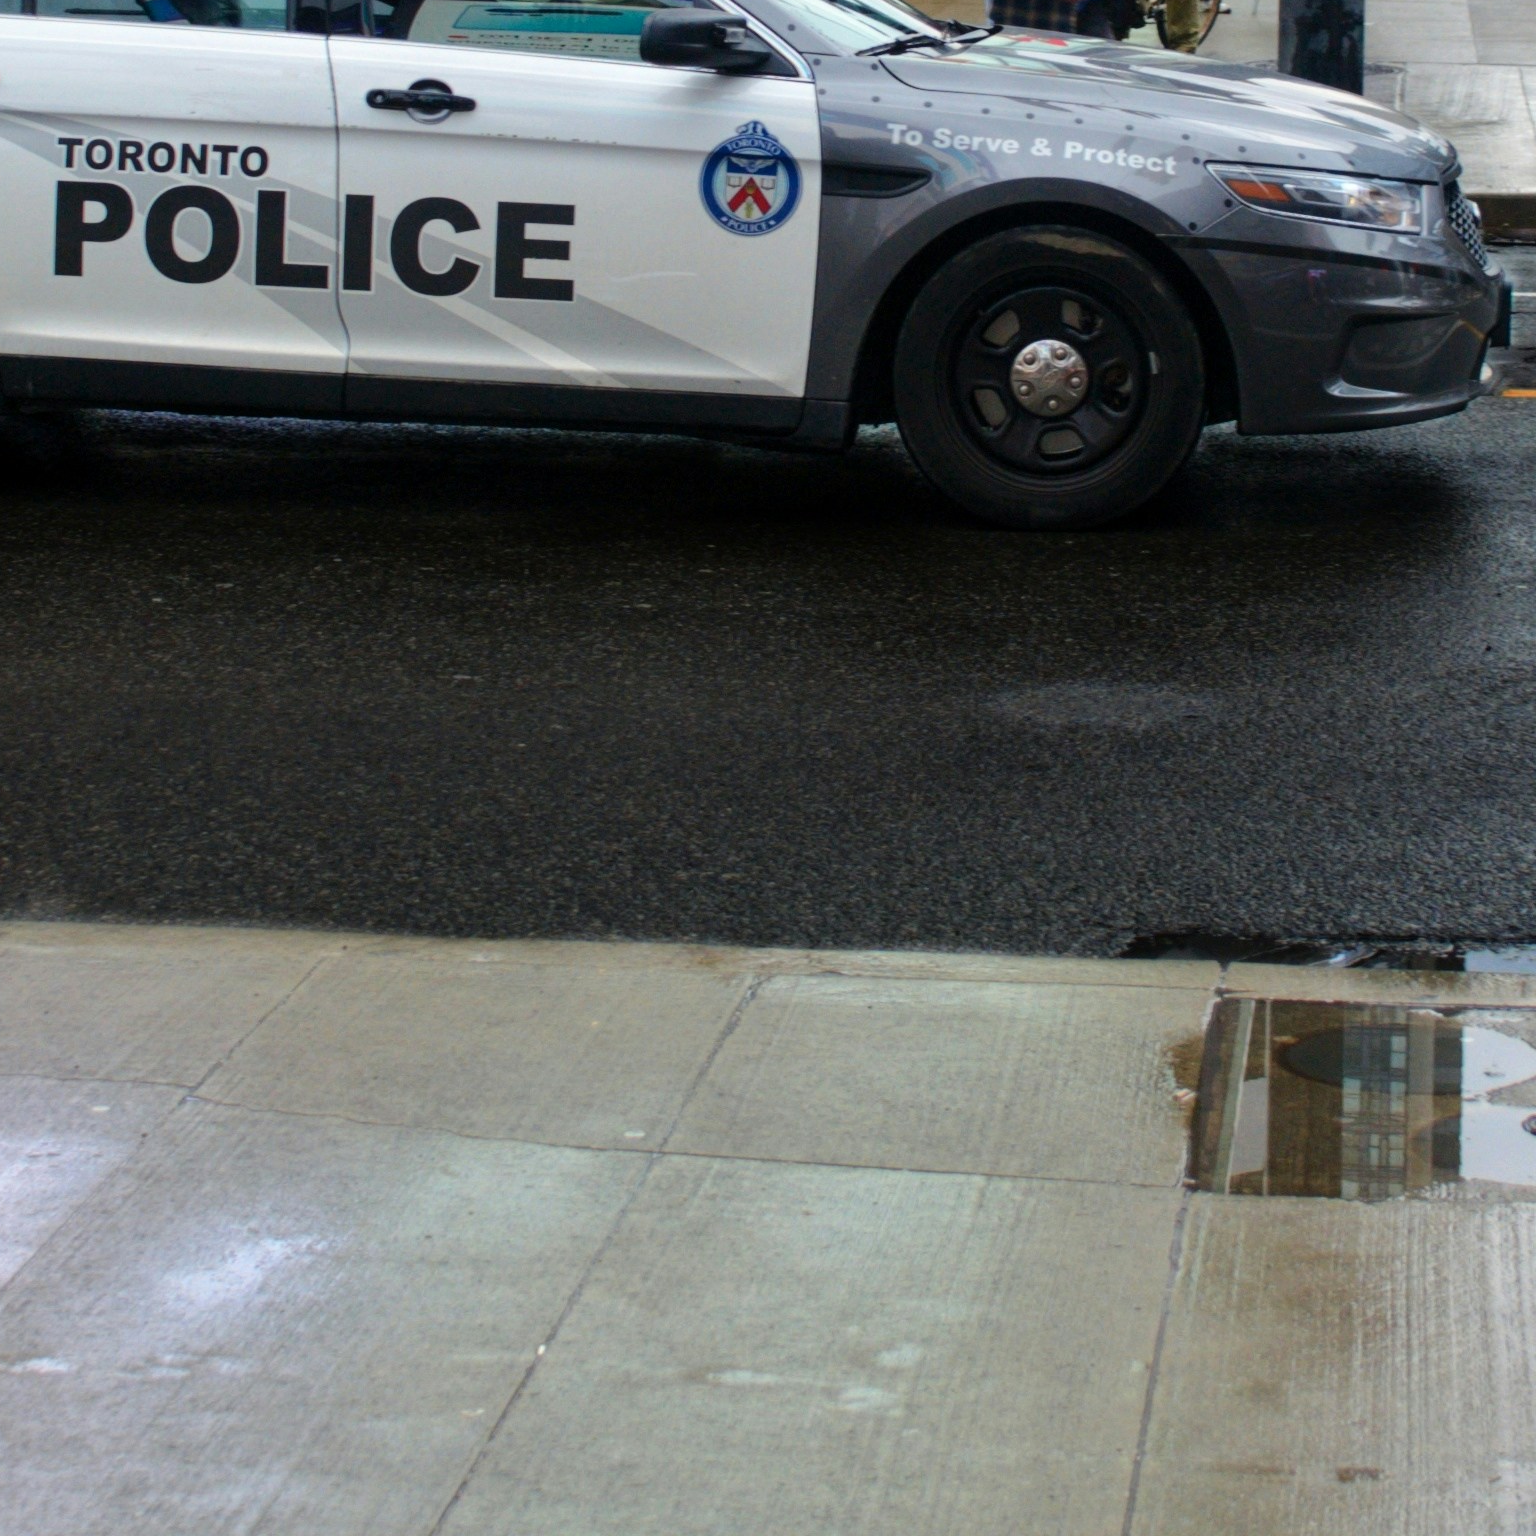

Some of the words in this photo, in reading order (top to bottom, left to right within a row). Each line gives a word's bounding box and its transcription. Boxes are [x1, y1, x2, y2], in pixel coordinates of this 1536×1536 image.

[57, 137, 269, 178] TORONTO
[725, 137, 782, 156] TORONTO
[886, 122, 923, 147] To
[931, 127, 1020, 155] Serve
[1030, 137, 1053, 157] &
[1063, 140, 1178, 176] Protect
[53, 179, 577, 302] POLICE
[728, 220, 769, 233] POLICE
